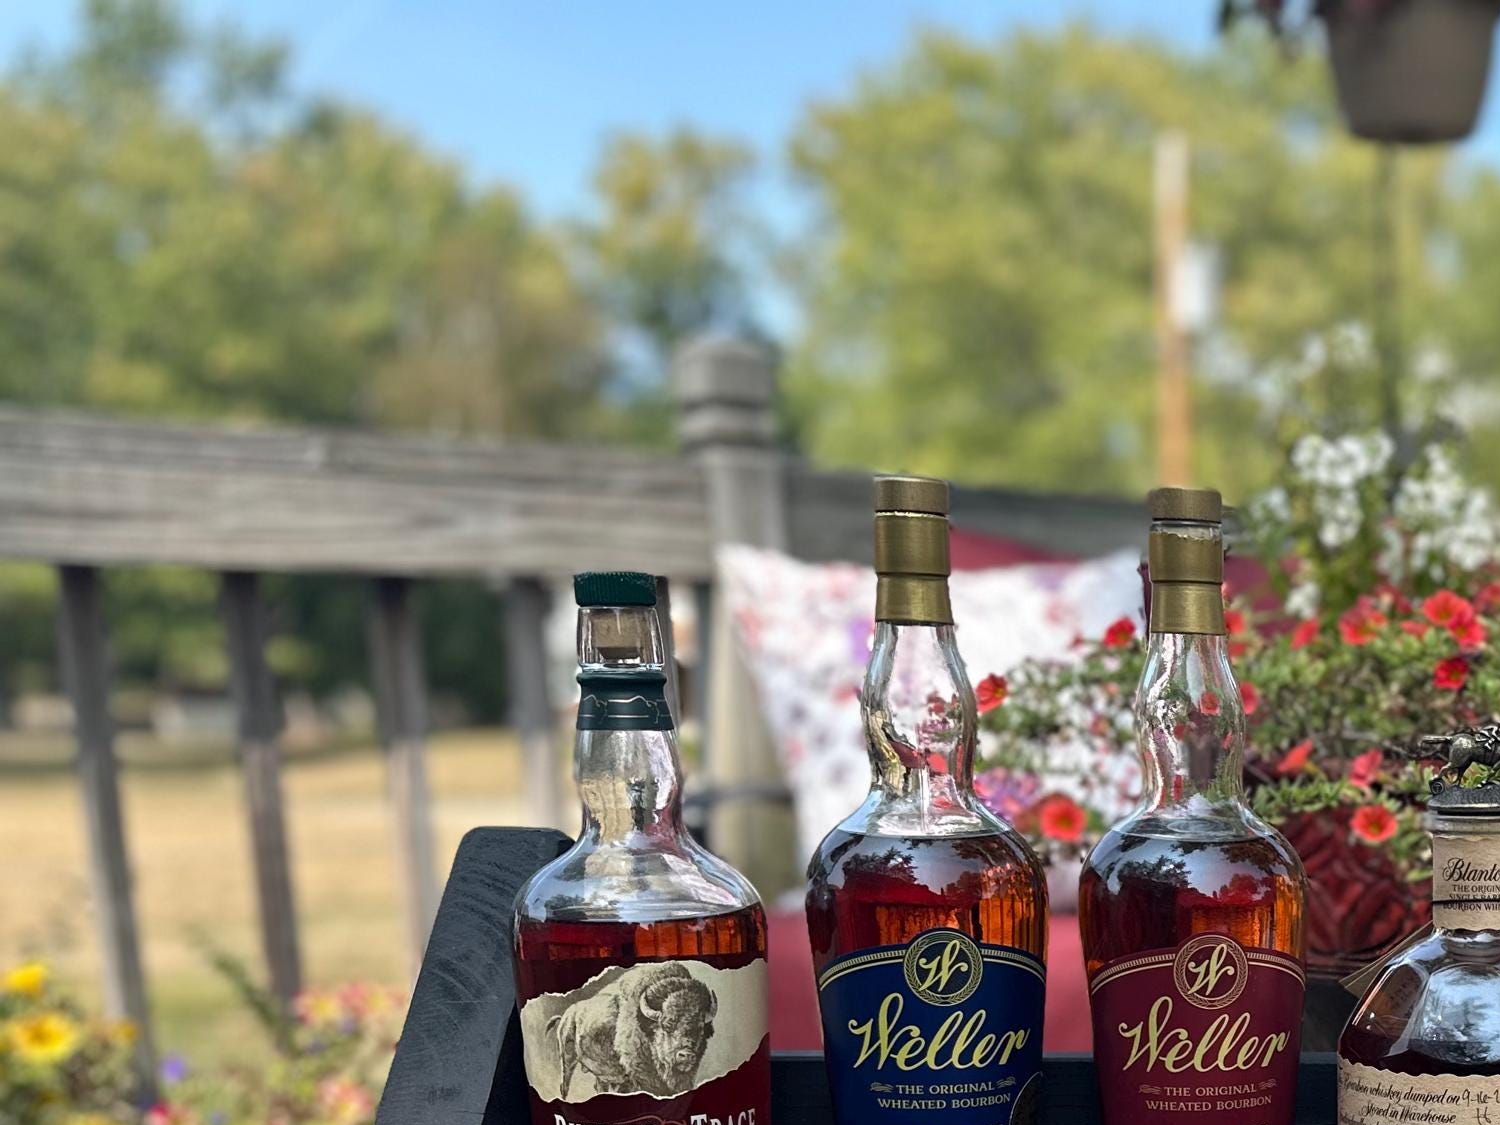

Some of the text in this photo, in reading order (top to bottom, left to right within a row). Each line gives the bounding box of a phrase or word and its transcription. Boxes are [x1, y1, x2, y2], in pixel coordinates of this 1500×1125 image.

[1452, 884, 1469, 892] THE
[848, 993, 1031, 1071] Weller
[1118, 996, 1291, 1073] Weller
[896, 1081, 995, 1095] THE ORIGINAL
[1164, 1083, 1257, 1097] THE ORIGINAL
[1369, 1083, 1402, 1104] whiskey
[1404, 1087, 1448, 1106] dumped
[1447, 1094, 1460, 1106] on
[877, 1093, 1011, 1110] WHEATED BOURBON
[1145, 1095, 1273, 1112] WHEATED BOURBON
[1400, 1104, 1457, 1124] Warehouse
